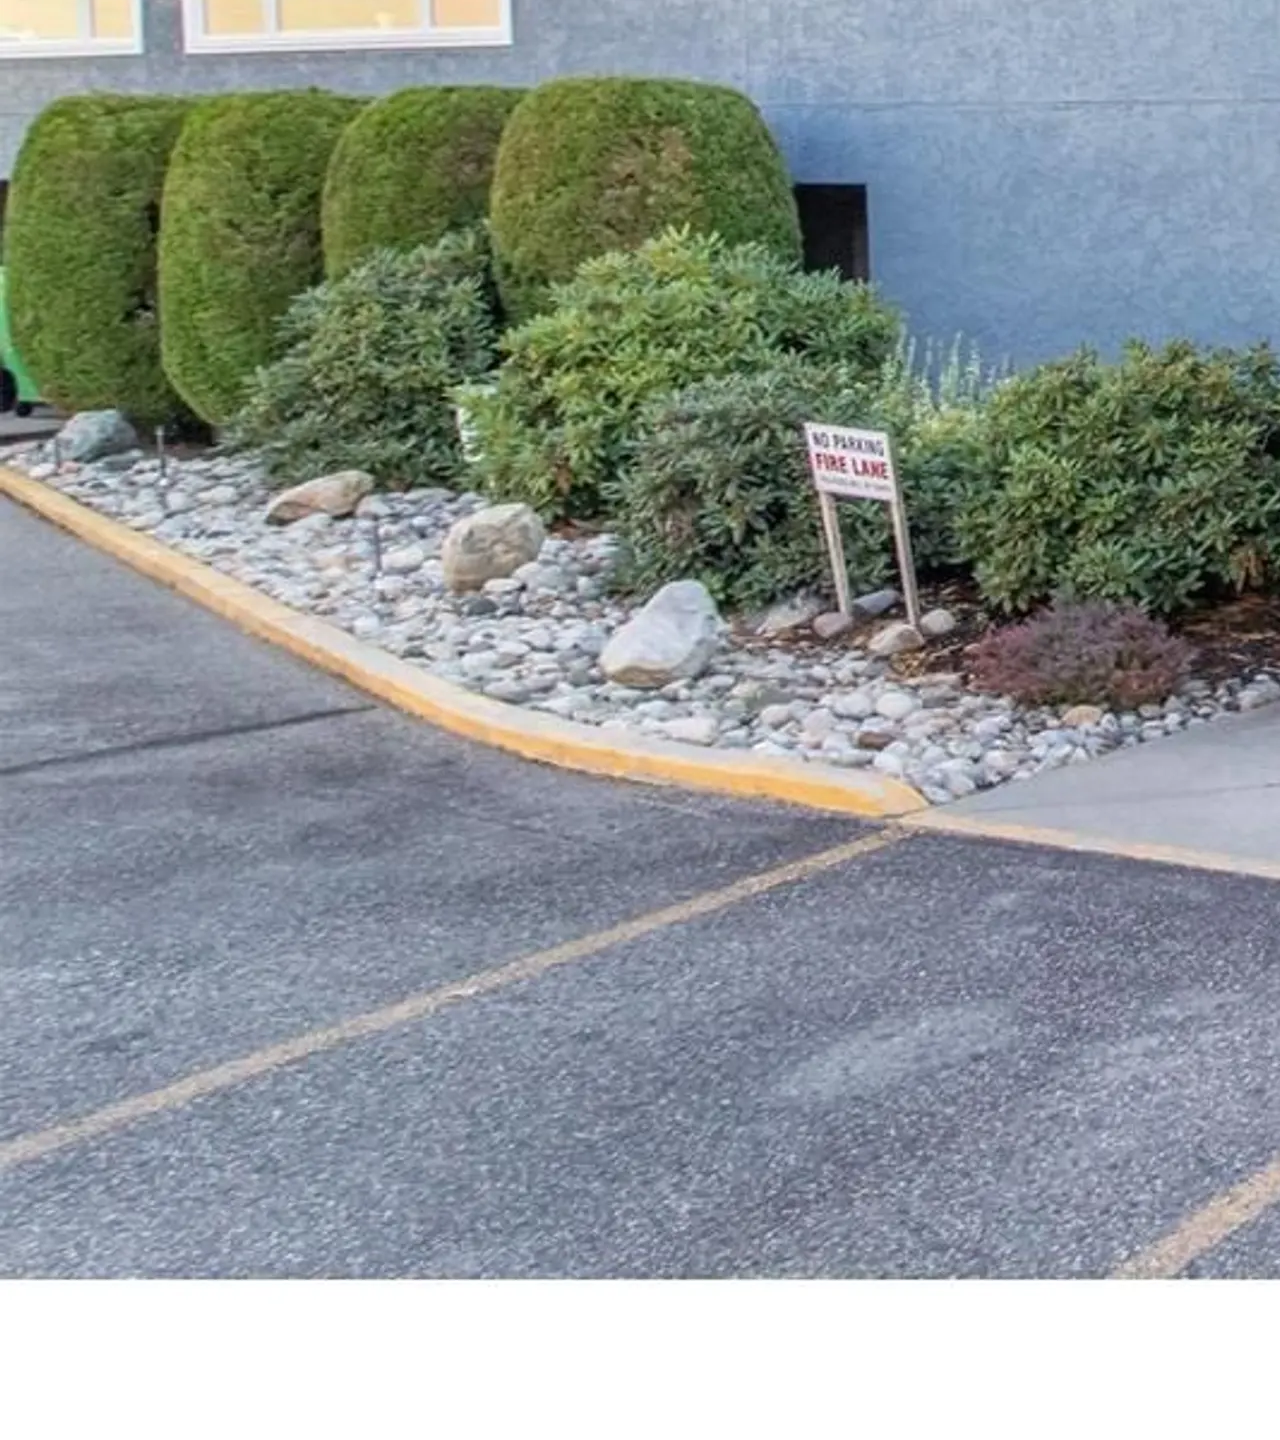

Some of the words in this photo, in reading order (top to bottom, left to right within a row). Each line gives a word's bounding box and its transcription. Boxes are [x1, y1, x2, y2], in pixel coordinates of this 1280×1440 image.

[812, 432, 830, 448] NO
[832, 434, 884, 456] PARKING
[816, 453, 847, 473] FIRE
[852, 457, 888, 479] LANE
